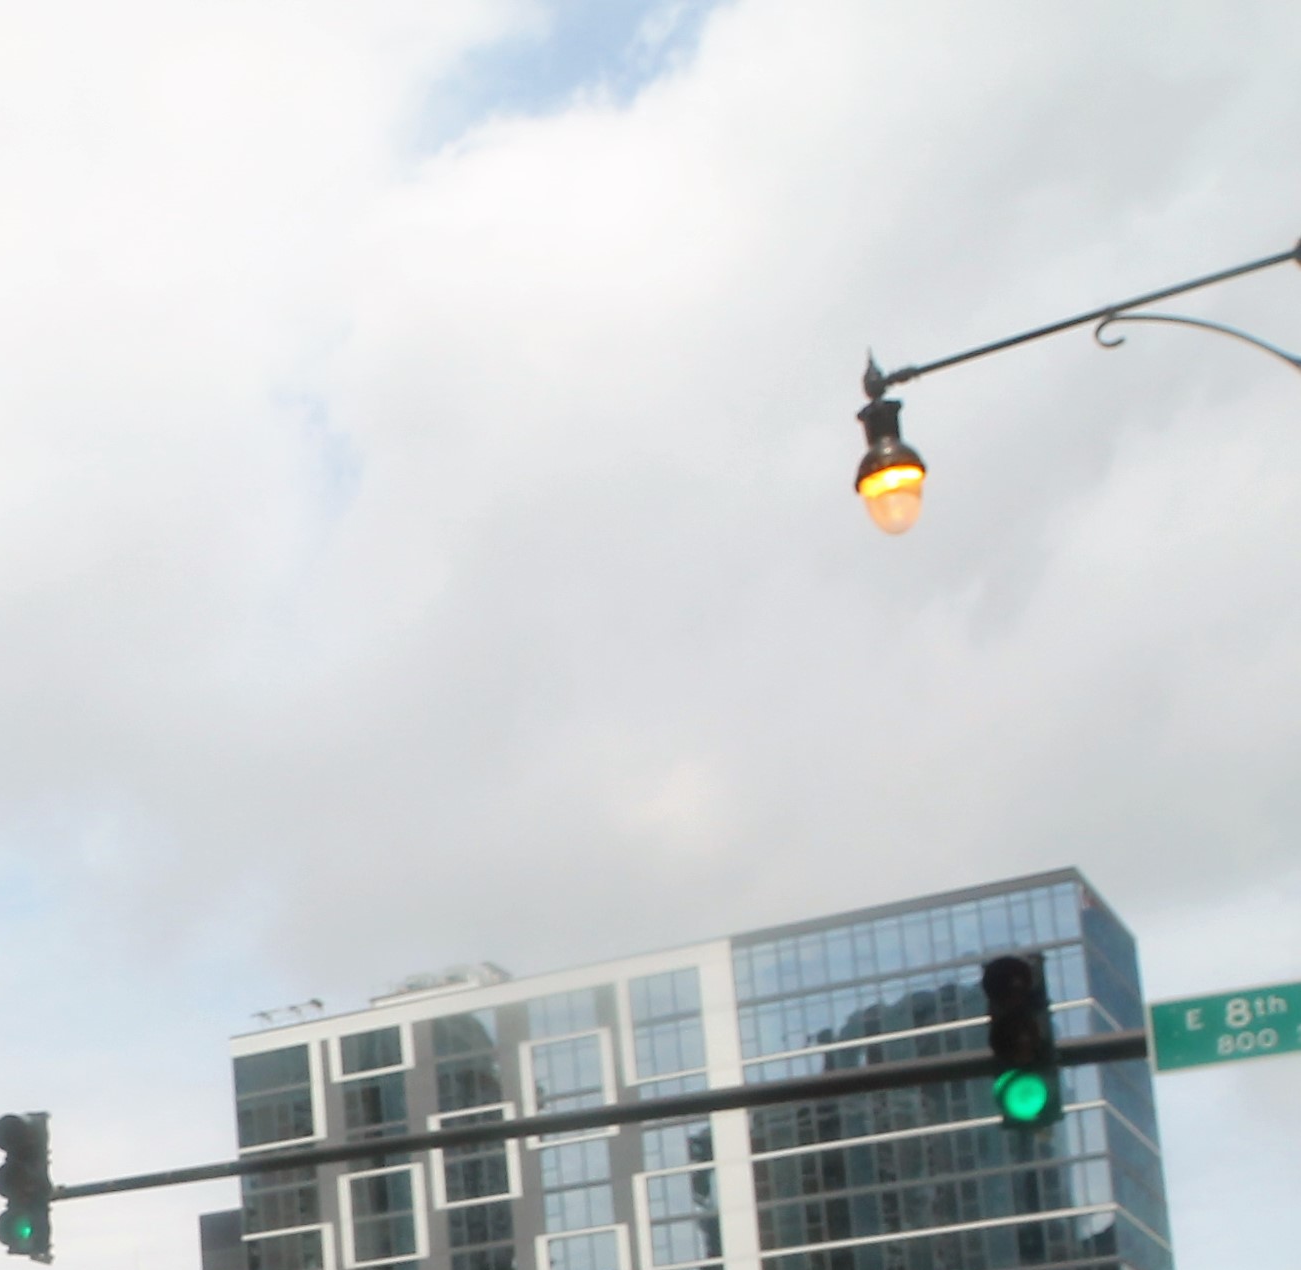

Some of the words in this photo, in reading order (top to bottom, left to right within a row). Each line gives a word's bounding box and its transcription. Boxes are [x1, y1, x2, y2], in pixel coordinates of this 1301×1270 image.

[1185, 1008, 1205, 1031] E
[1225, 994, 1288, 1028] 8th
[1217, 1027, 1279, 1056] 800
